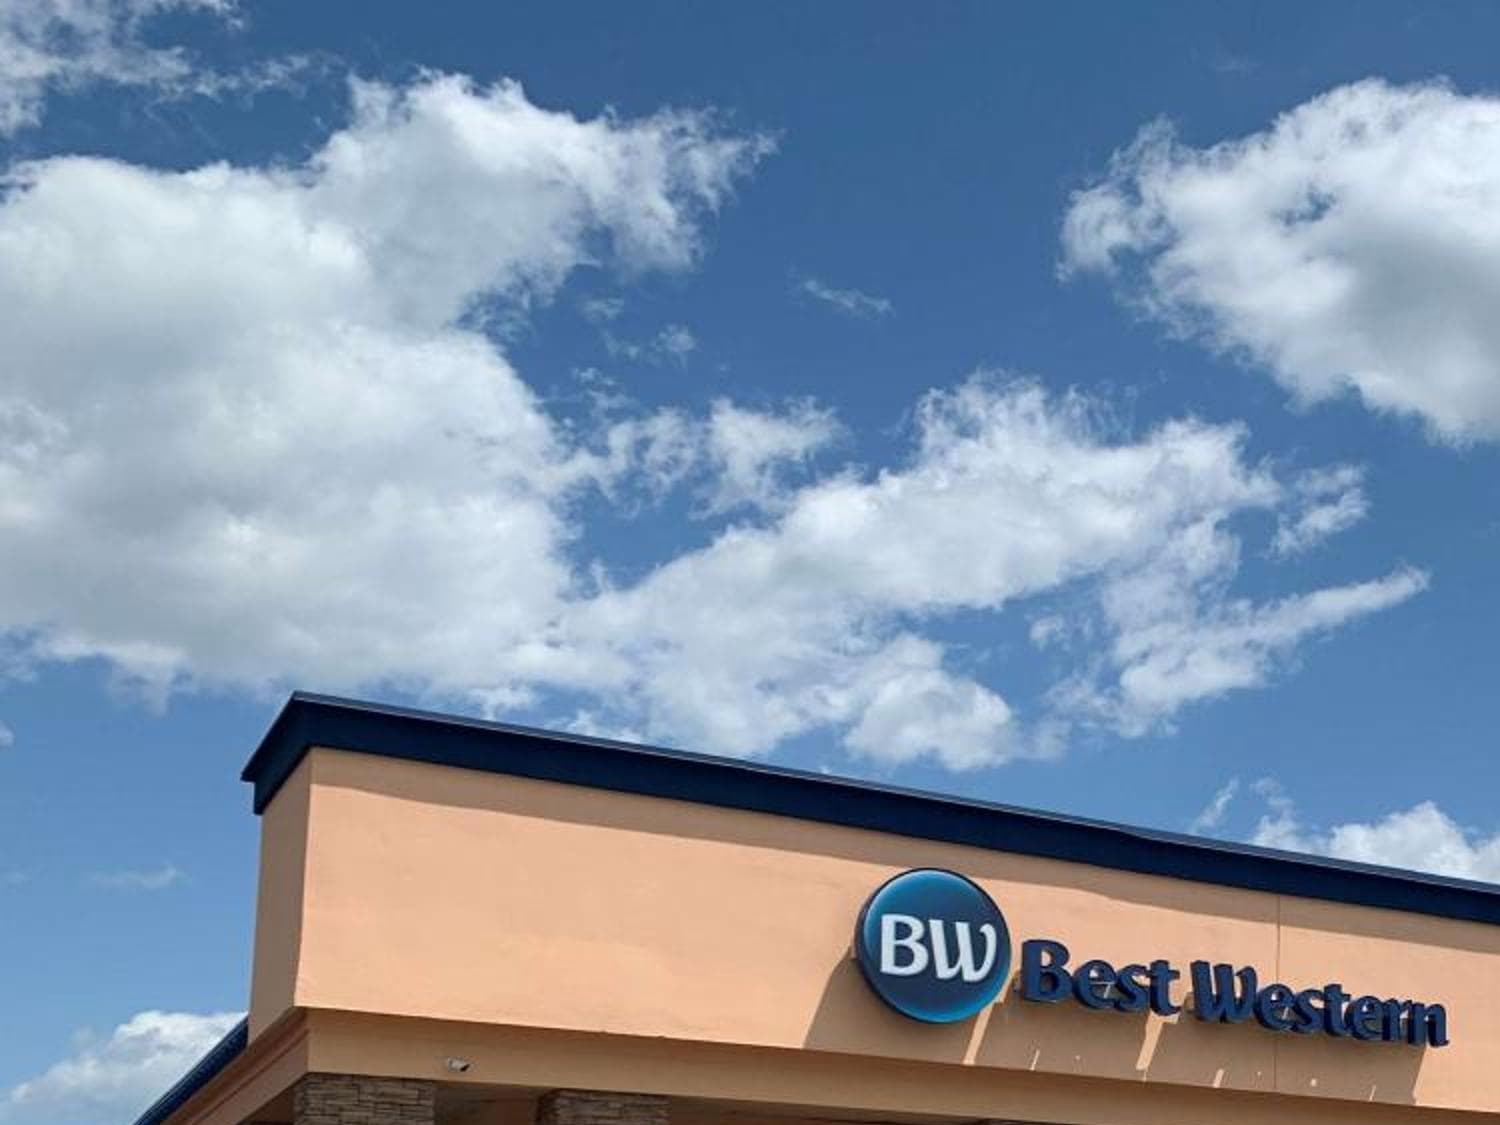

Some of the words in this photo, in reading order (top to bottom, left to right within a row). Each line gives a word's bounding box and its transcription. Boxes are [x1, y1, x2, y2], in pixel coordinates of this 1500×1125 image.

[880, 914, 996, 981] BW
[1021, 939, 1180, 1015] Best
[1192, 960, 1449, 1047] Western
